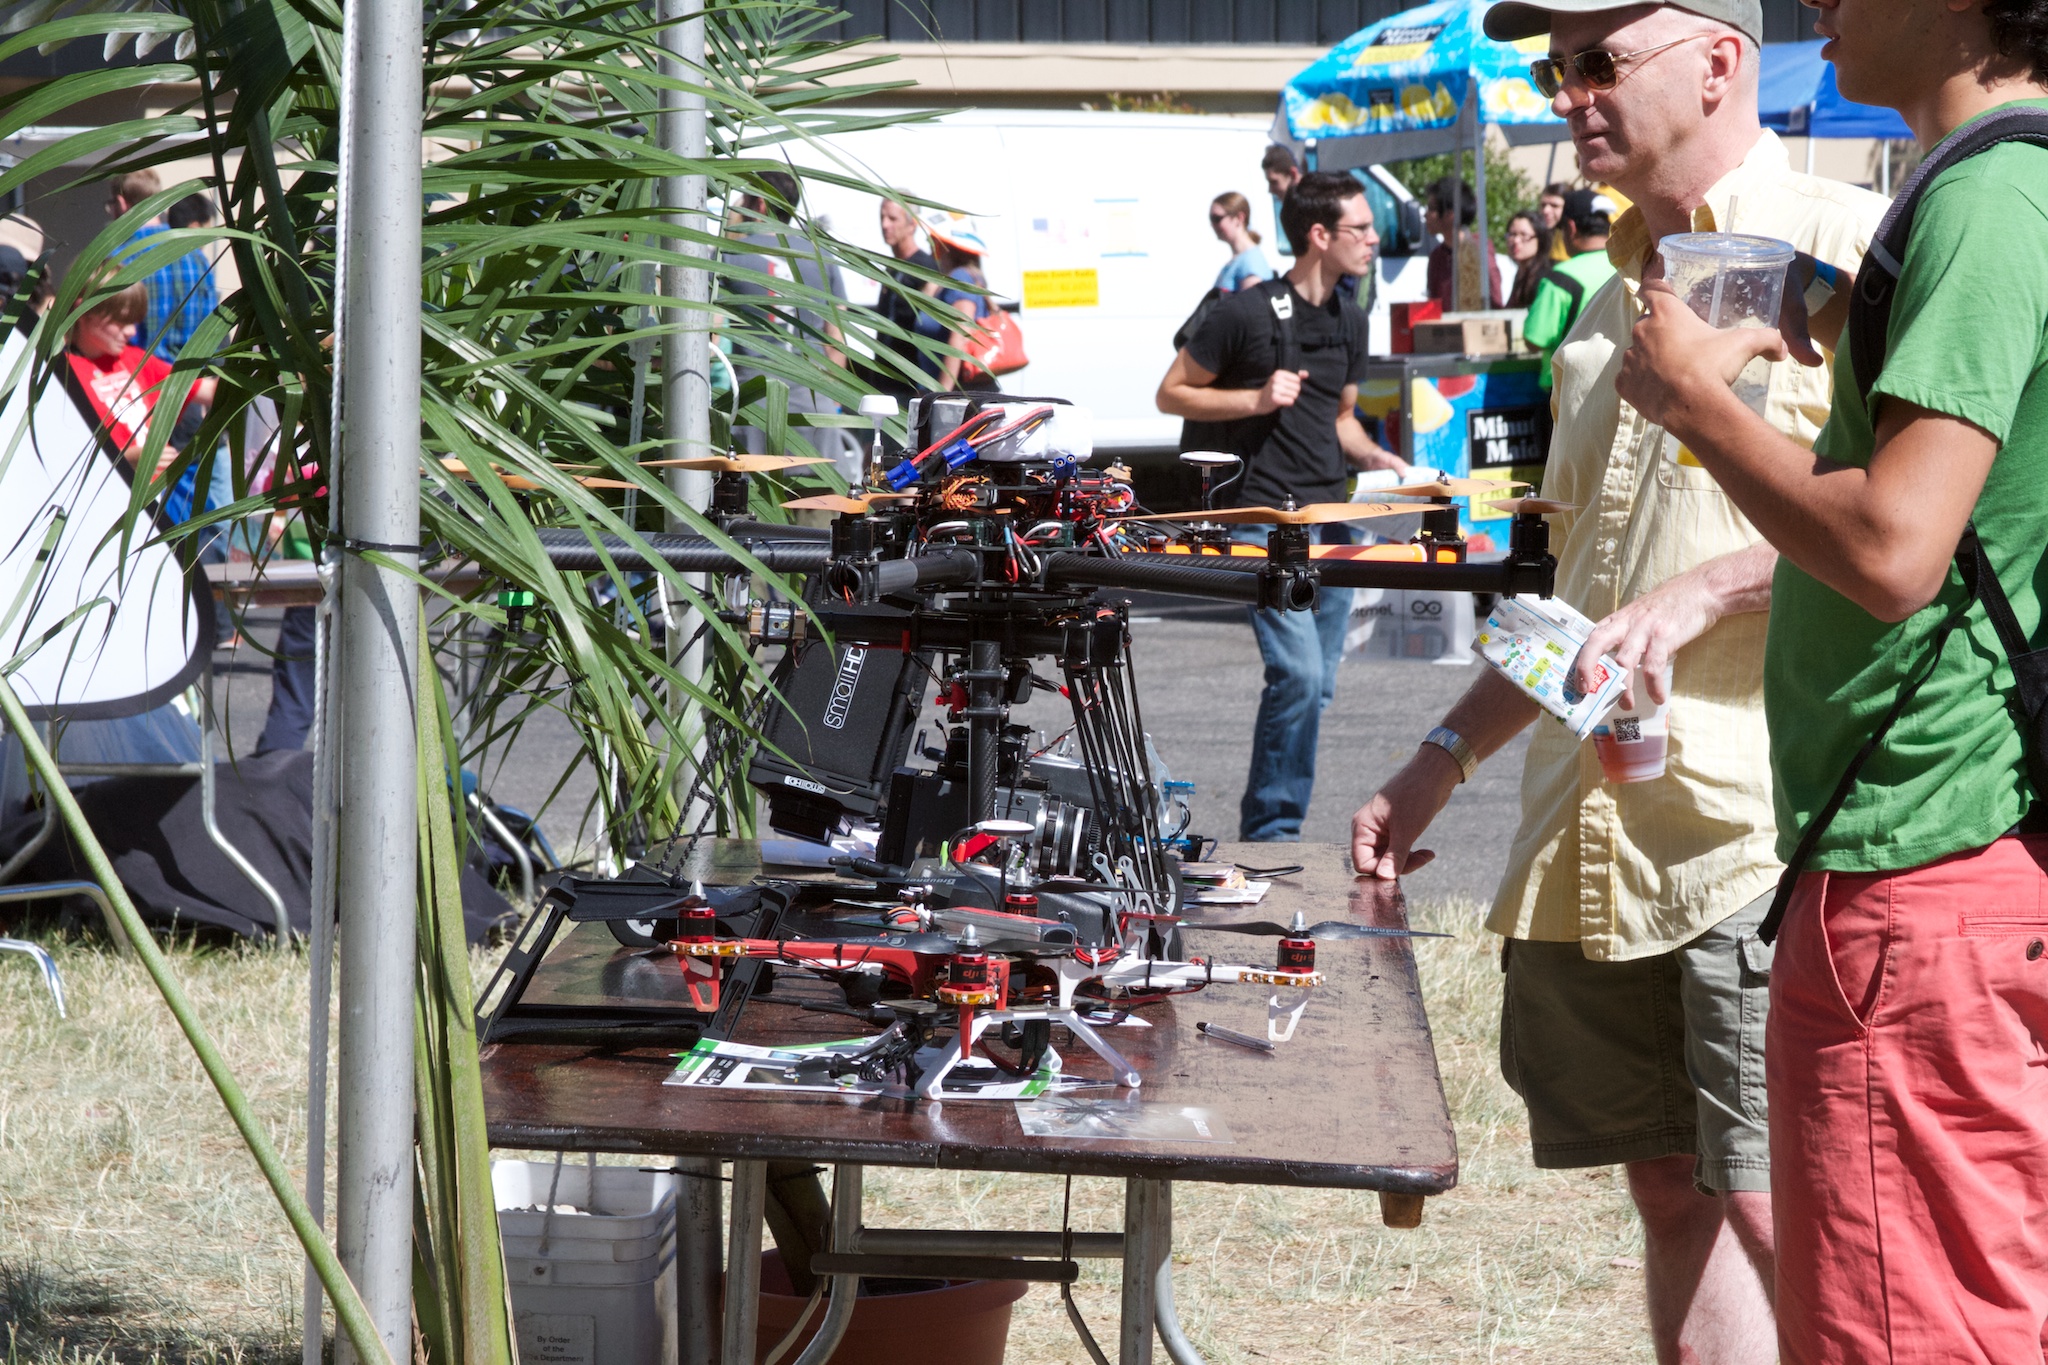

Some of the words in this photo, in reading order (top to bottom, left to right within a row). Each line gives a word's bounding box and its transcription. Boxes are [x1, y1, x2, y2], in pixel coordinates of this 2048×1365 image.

[1473, 414, 1537, 441] Minut
[826, 645, 865, 728] smallHD
[537, 1335, 547, 1344] By
[548, 1335, 571, 1344] Order
